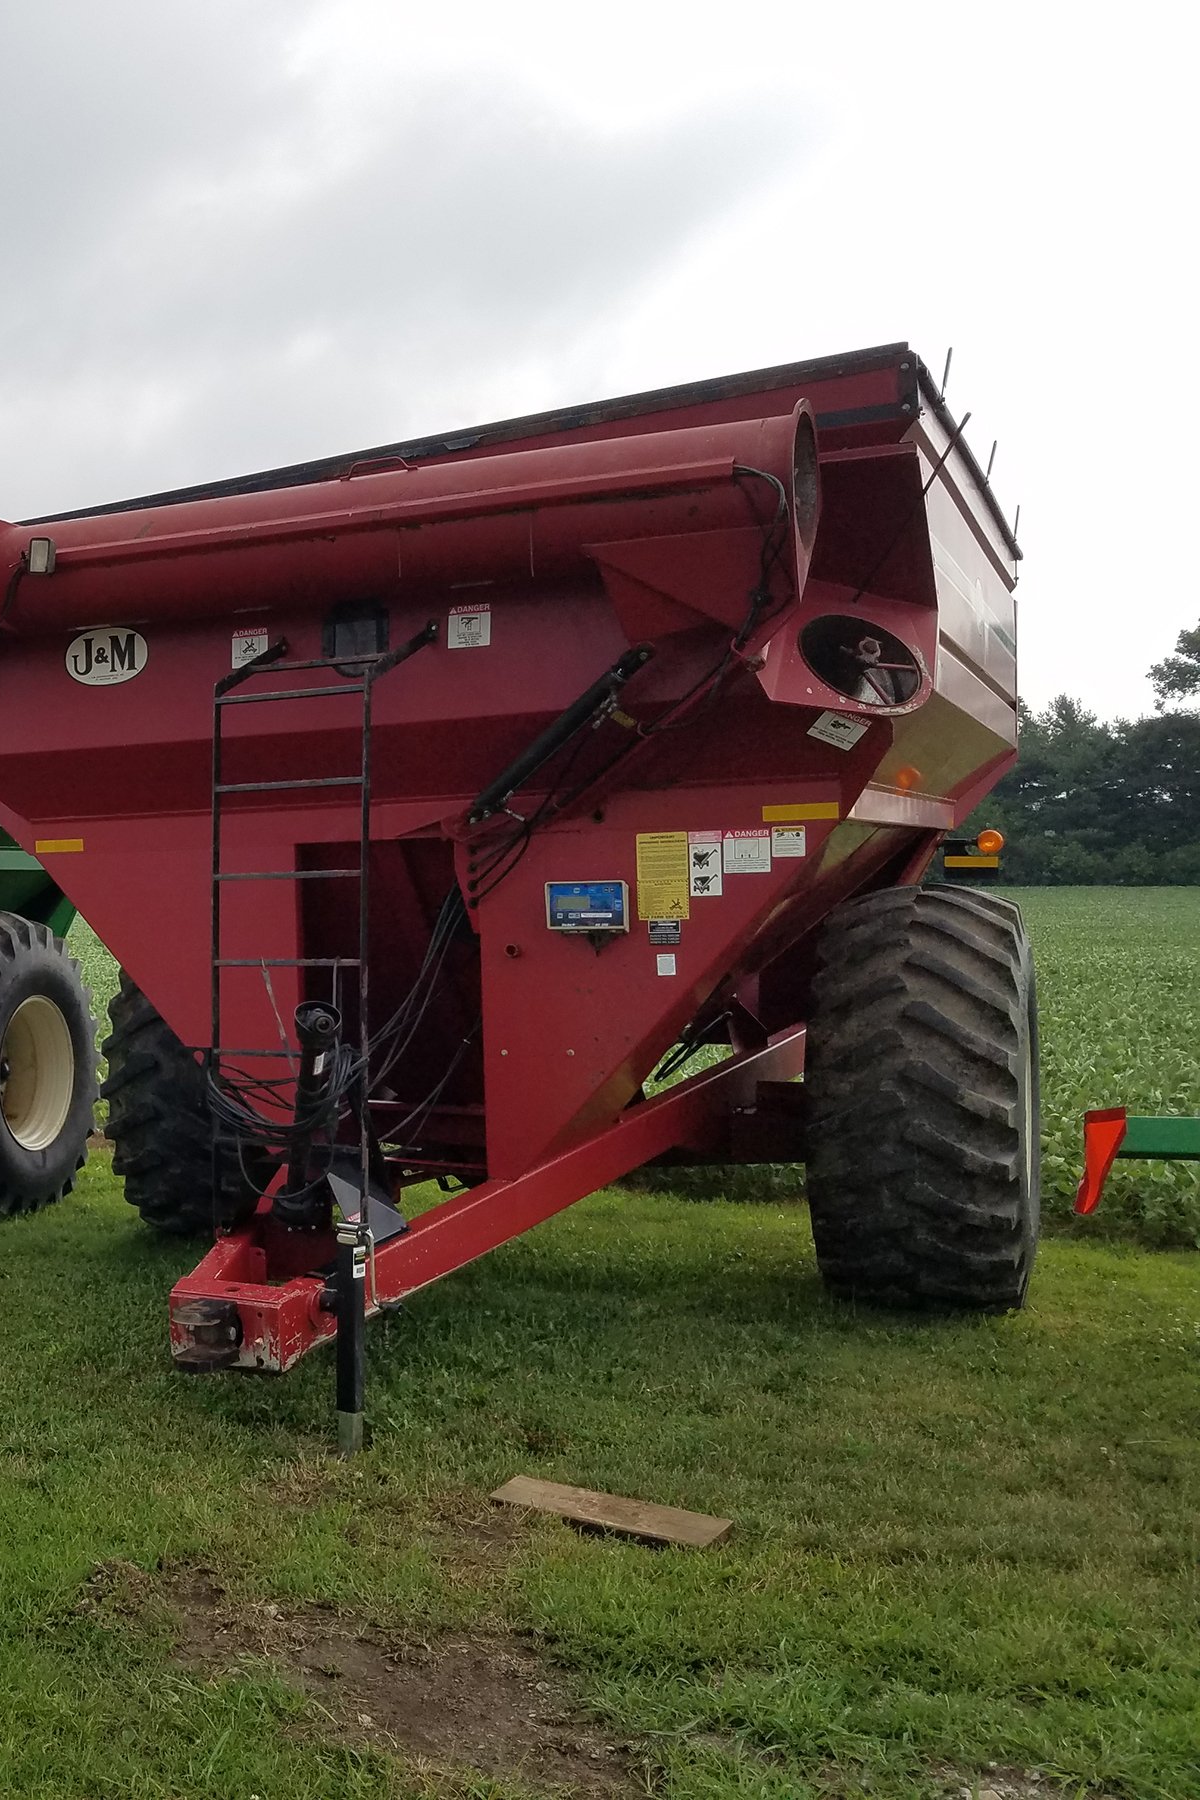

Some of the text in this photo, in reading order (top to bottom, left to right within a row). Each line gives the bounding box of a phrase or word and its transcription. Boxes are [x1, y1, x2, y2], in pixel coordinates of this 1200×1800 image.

[457, 603, 490, 613] DANGER
[240, 628, 268, 637] DANGER
[71, 633, 138, 676] J&M
[734, 829, 770, 838] DANGER
